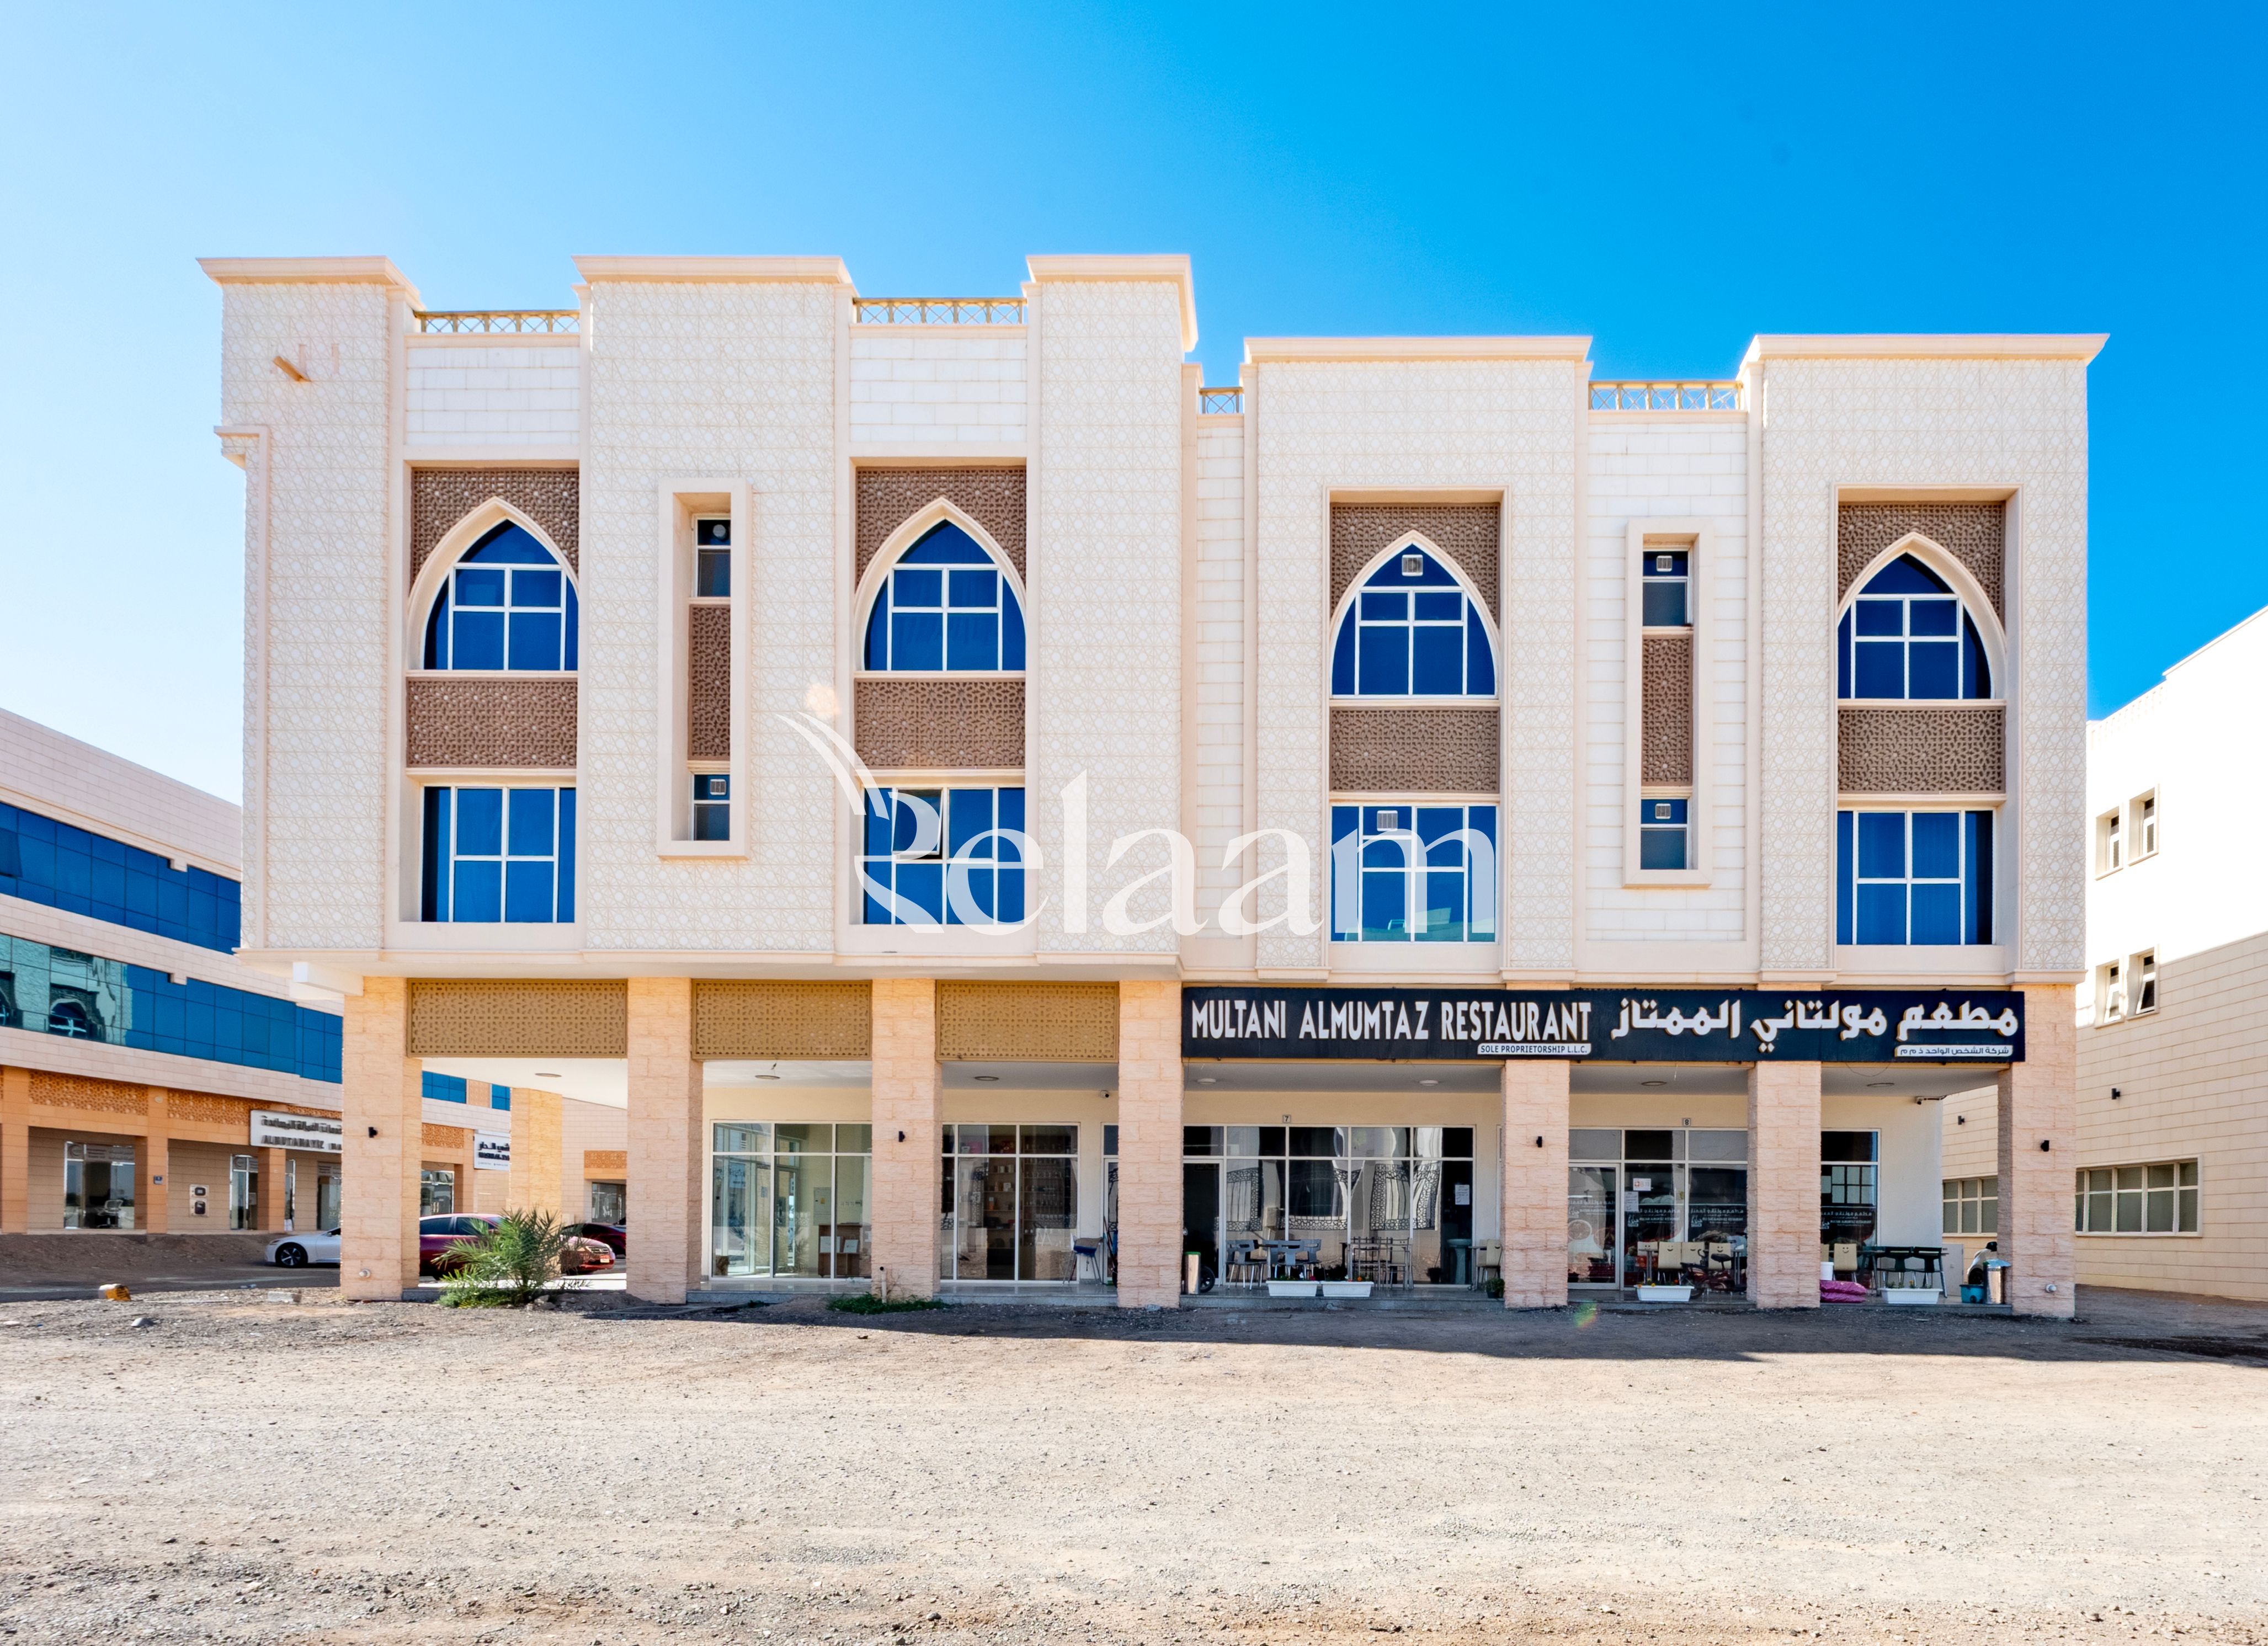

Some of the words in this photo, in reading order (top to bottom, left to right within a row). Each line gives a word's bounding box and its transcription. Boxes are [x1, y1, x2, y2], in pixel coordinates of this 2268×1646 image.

[1191, 1000, 1286, 1039] MULTANI
[1299, 1000, 1429, 1040] ALMUMTAZ
[1441, 1001, 1591, 1041] RESTAURANT
[1610, 998, 1741, 1040] الممتاز
[1750, 999, 1888, 1053] مولتاني
[1897, 1001, 2019, 1042] مطعم
[1501, 1045, 1566, 1053] PROPRIETORSHIP
[1567, 1045, 1588, 1053] L.L.C.
[1951, 1046, 1984, 1056] الشخص
[1985, 1046, 2009, 1056] شركة
